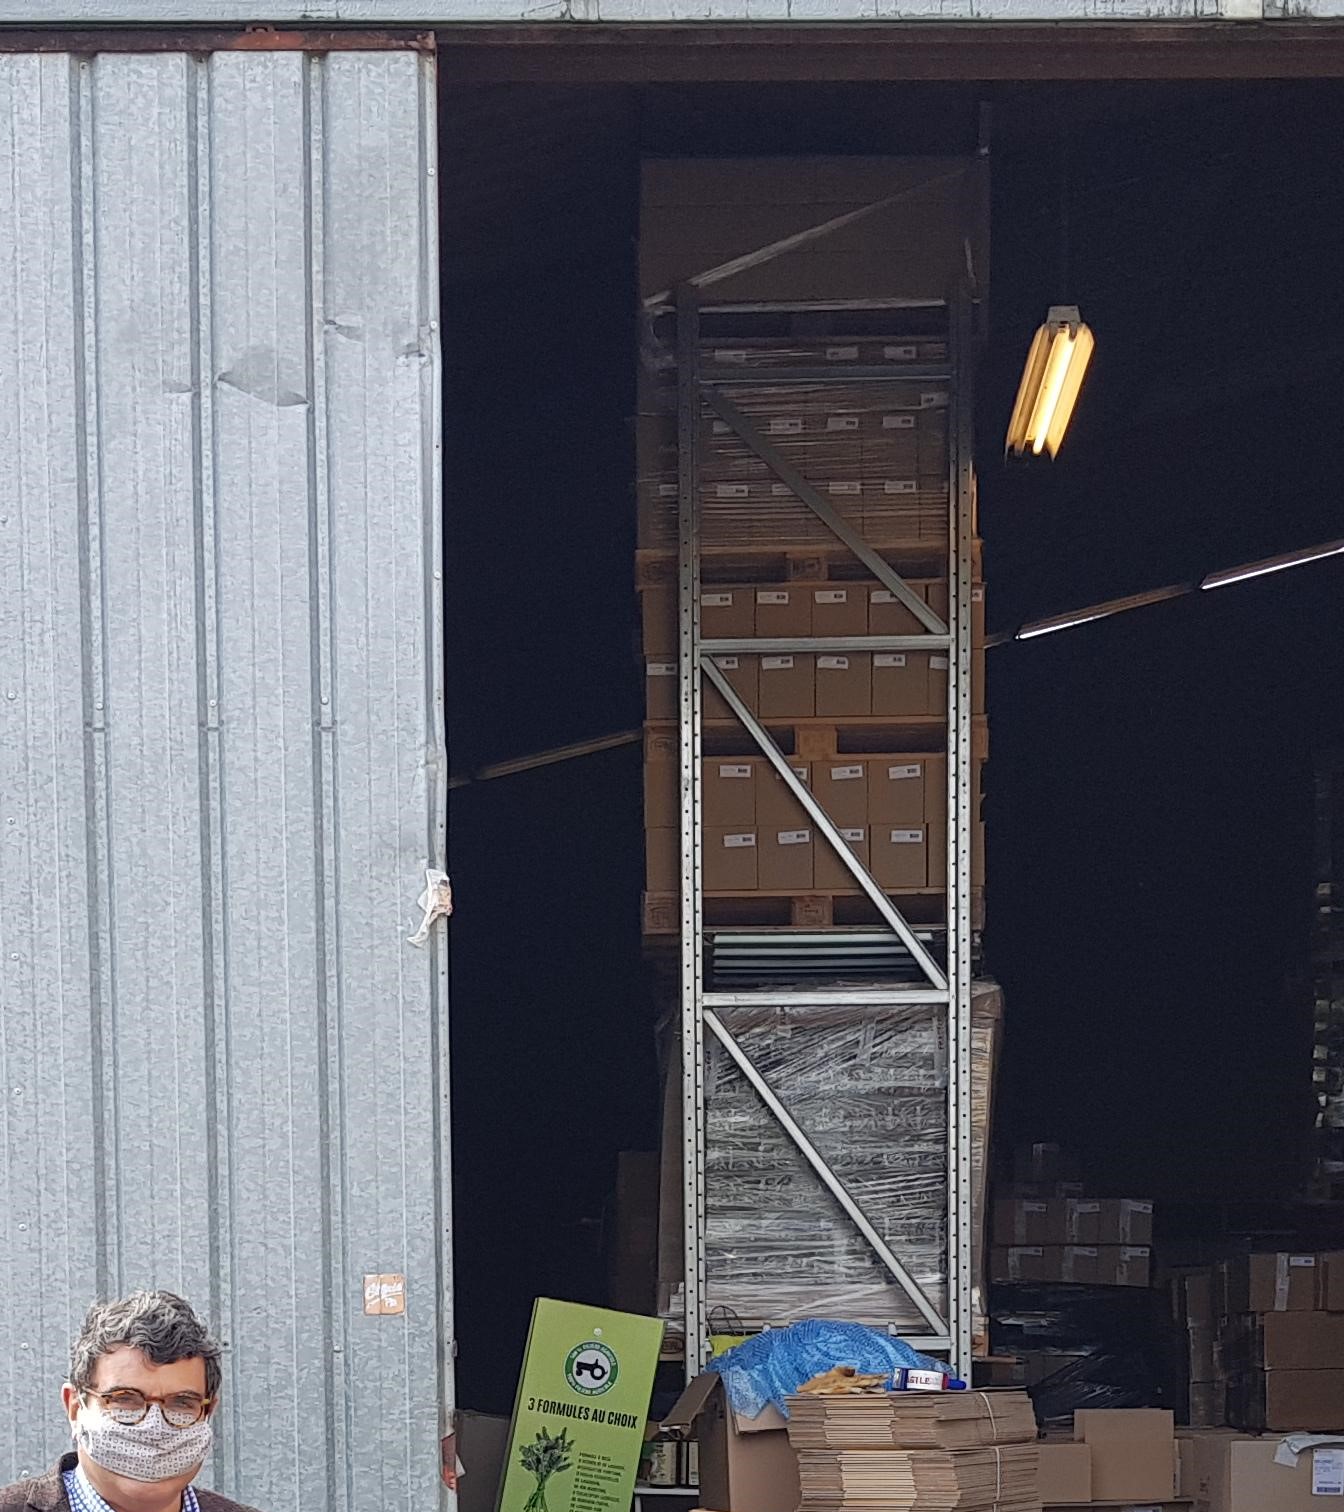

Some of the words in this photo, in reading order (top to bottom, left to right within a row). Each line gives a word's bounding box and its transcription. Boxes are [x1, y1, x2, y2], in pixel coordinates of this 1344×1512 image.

[528, 1398, 535, 1411] 3
[536, 1399, 590, 1420] FORMULES
[591, 1408, 606, 1423] AU
[607, 1411, 638, 1429] CHOIX
